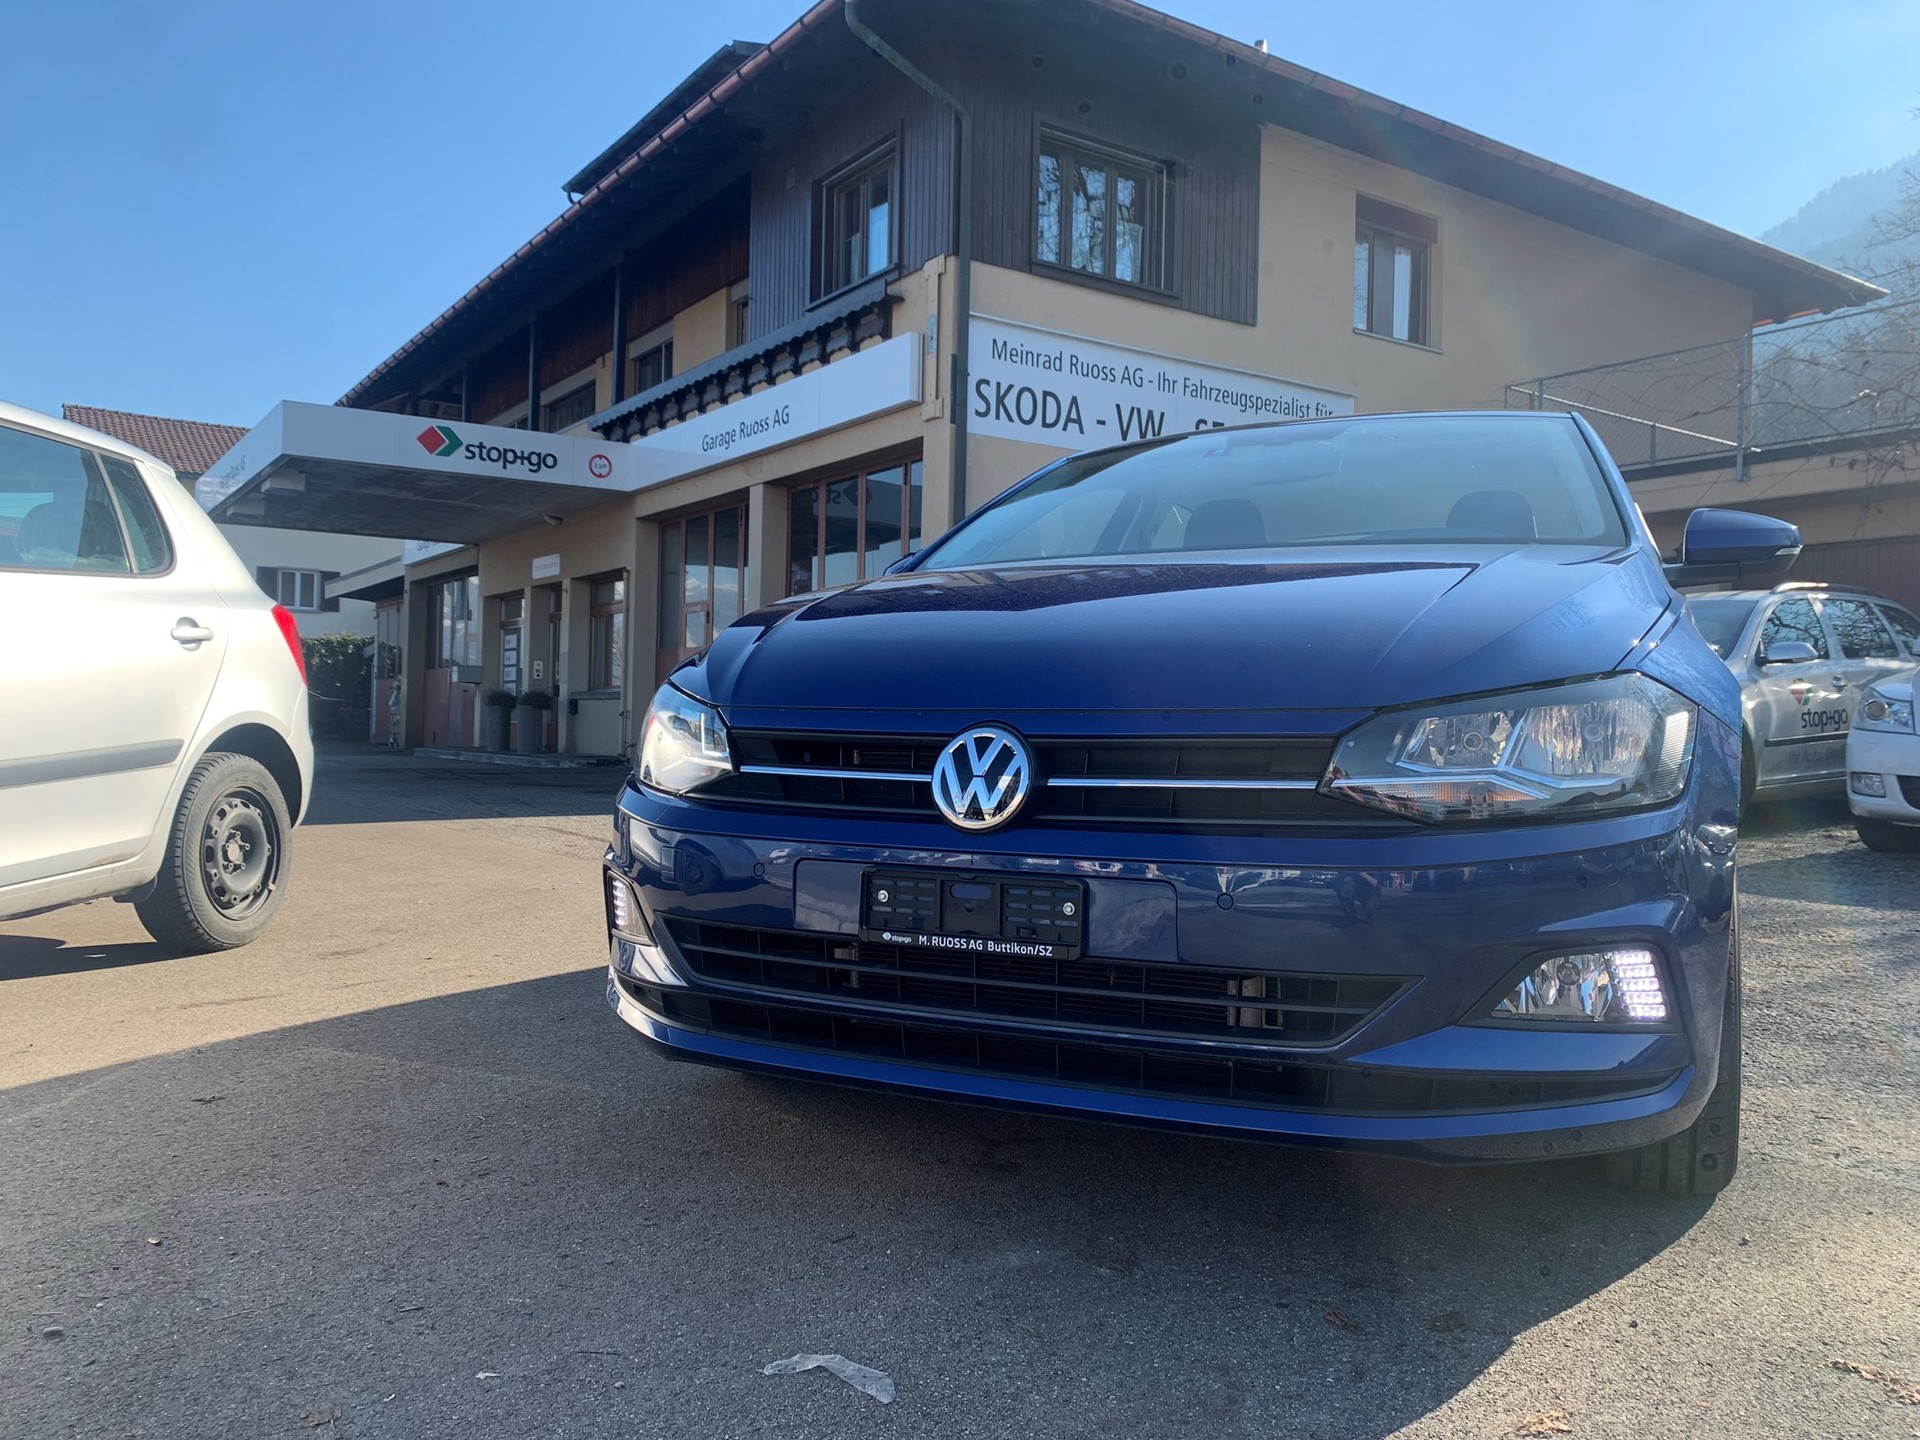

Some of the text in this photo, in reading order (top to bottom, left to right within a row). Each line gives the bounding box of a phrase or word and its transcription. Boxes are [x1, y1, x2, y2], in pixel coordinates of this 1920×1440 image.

[992, 338, 1063, 373] Meinrad
[1069, 354, 1117, 383] Ruoss
[1120, 365, 1144, 388] AG
[1157, 371, 1178, 395] Ihr
[1182, 377, 1311, 419] Fahrzeugspezialist
[702, 404, 790, 453] Garage Ruoss AG
[974, 378, 1085, 435] SKODA
[1115, 403, 1165, 442] VW
[464, 441, 558, 474] stop+go
[1801, 708, 1849, 733] stop+go
[931, 936, 968, 949] RUOSS
[968, 940, 983, 951] AG
[987, 941, 1053, 957] Buttikon/SZ
